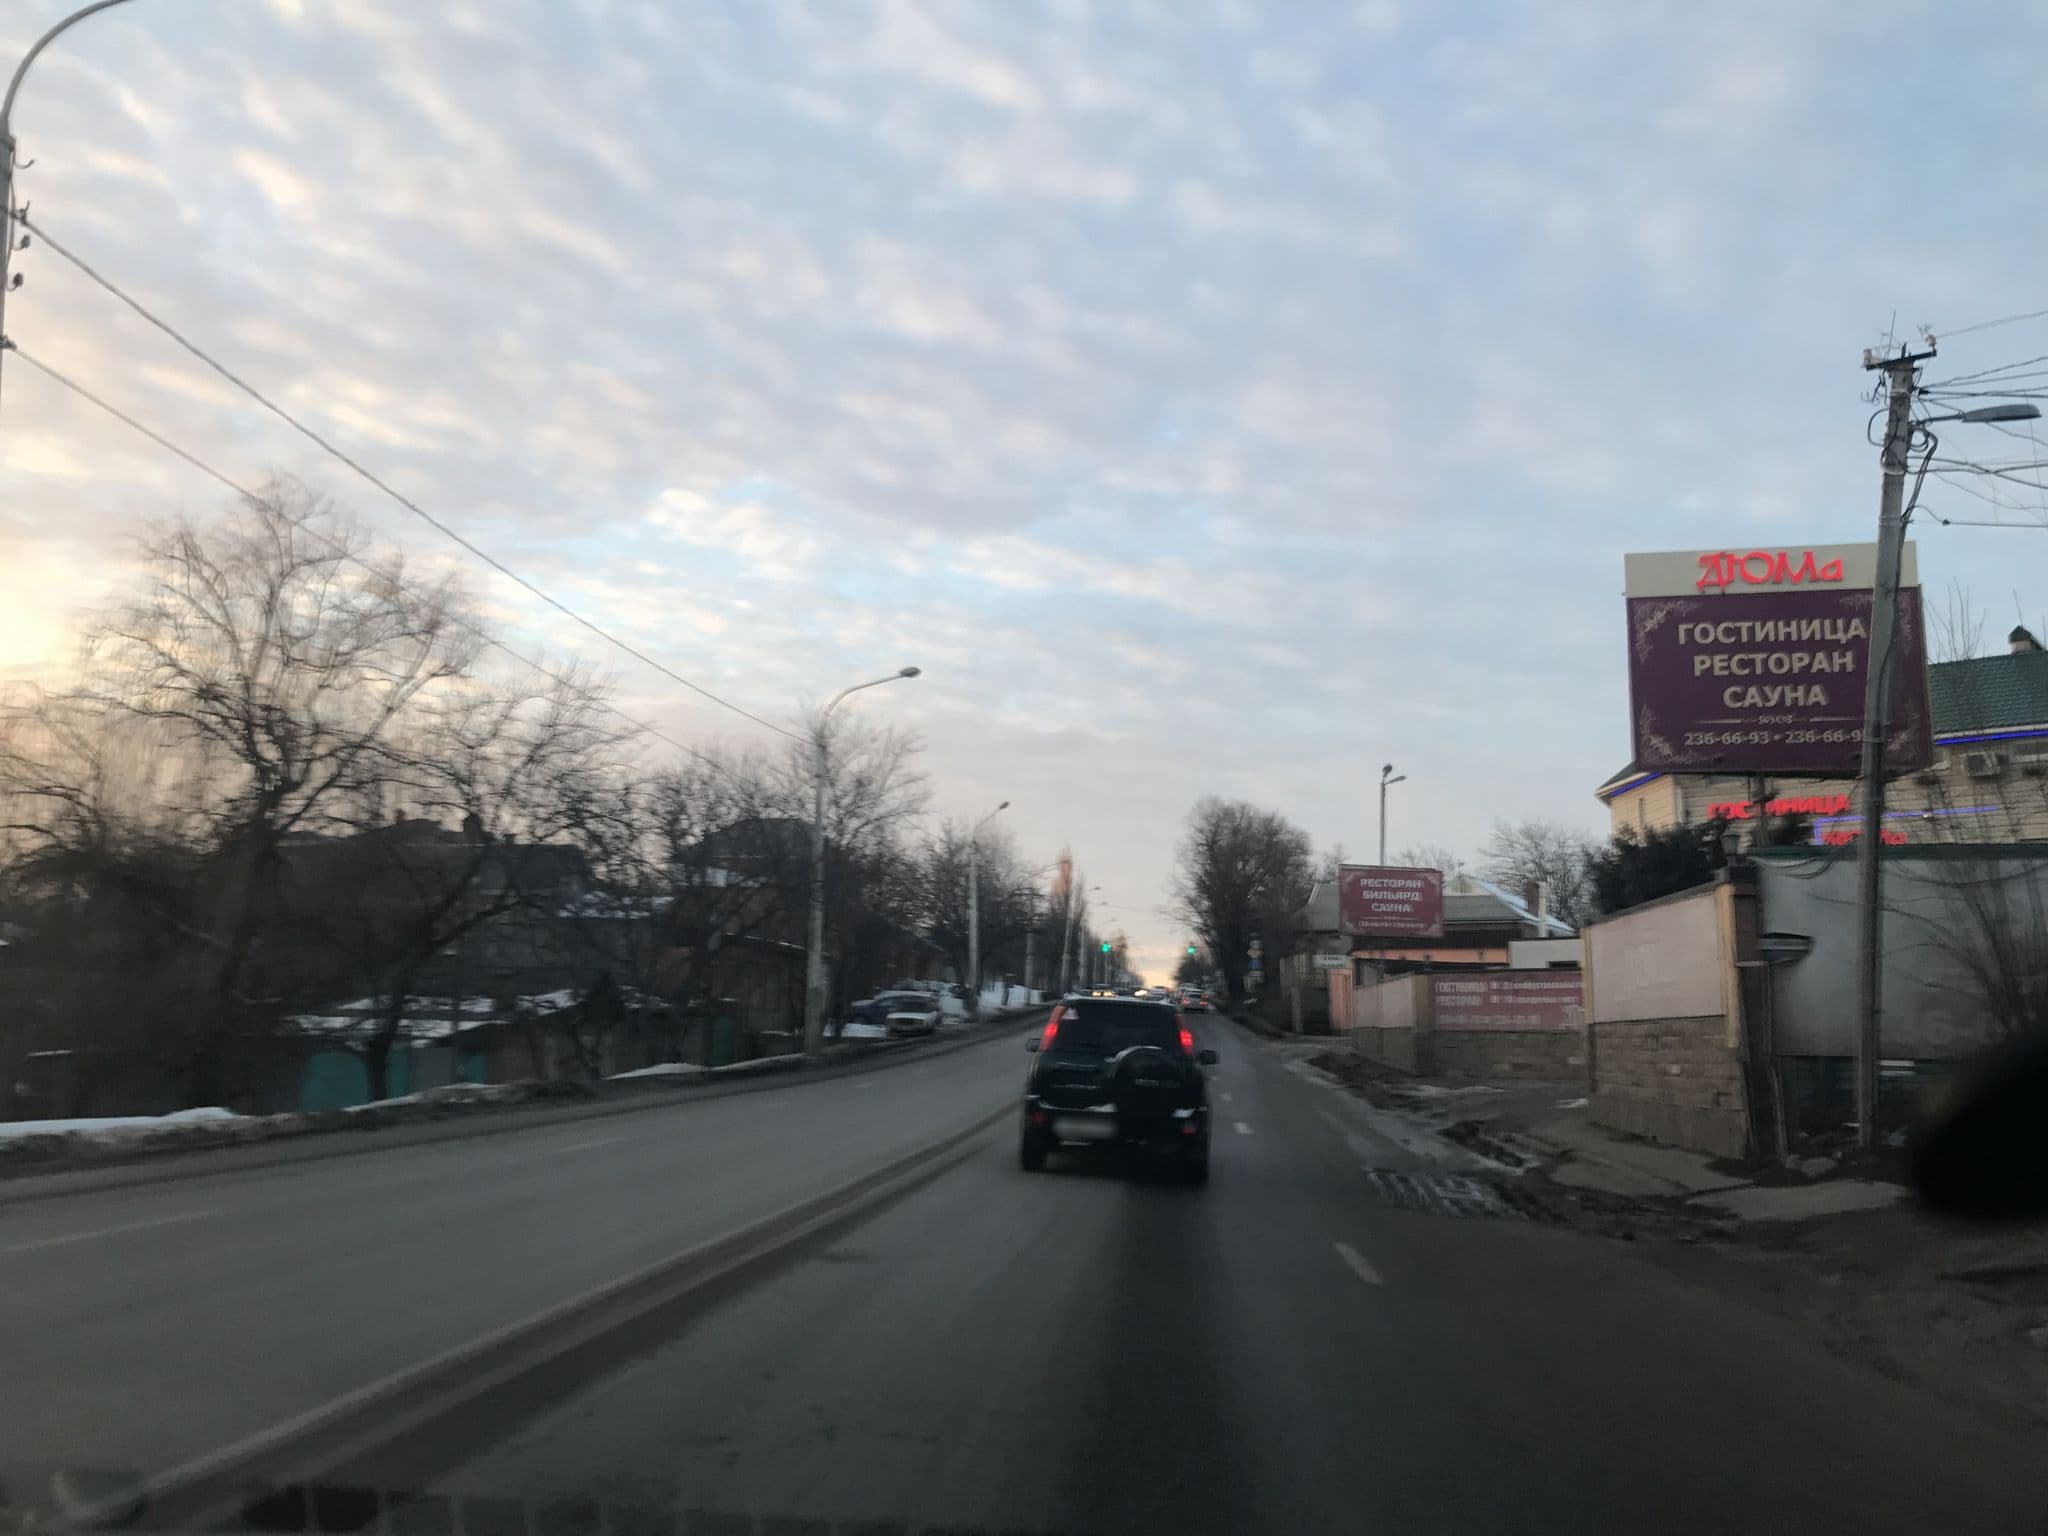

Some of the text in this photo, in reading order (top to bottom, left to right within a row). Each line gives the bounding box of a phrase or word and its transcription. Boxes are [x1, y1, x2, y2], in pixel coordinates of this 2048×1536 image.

[1678, 617, 1867, 645] ГОСТИНИЦА
[1693, 651, 1855, 677] РЕСТОРАН
[1723, 684, 1828, 708] САУНА
[1684, 728, 1866, 746] 236-66-93 236-66-9
[1360, 878, 1424, 888] РЕСТОРАН
[1362, 890, 1422, 902] БИЛЬЯРД
